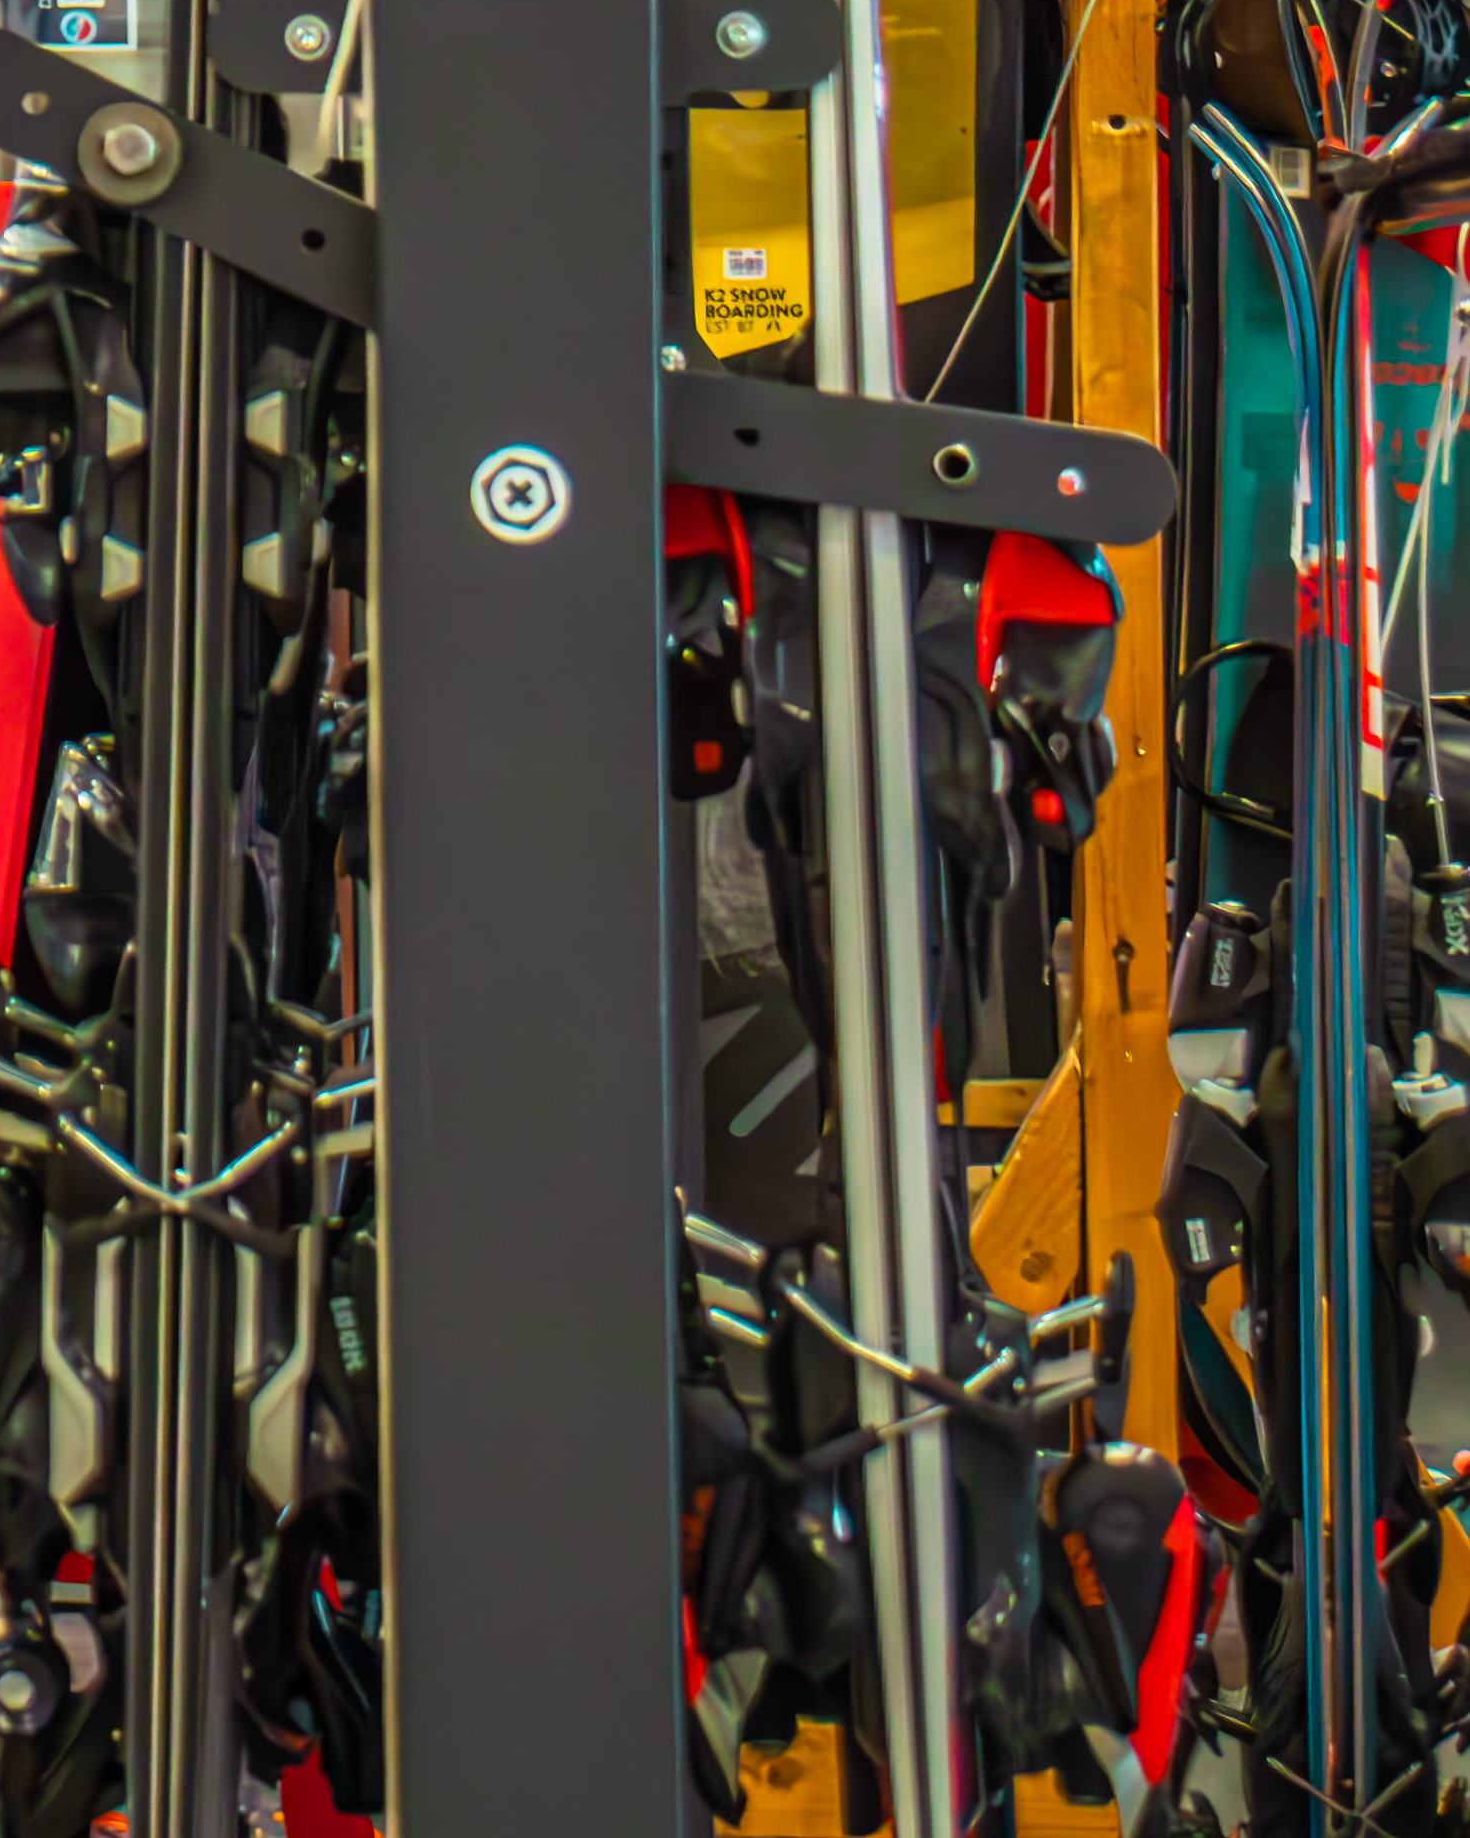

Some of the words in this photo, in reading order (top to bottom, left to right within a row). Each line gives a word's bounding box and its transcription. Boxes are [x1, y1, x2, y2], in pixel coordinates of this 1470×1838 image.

[704, 288, 726, 303] K2
[729, 287, 786, 303] SNOW
[705, 303, 804, 319] BOARDING
